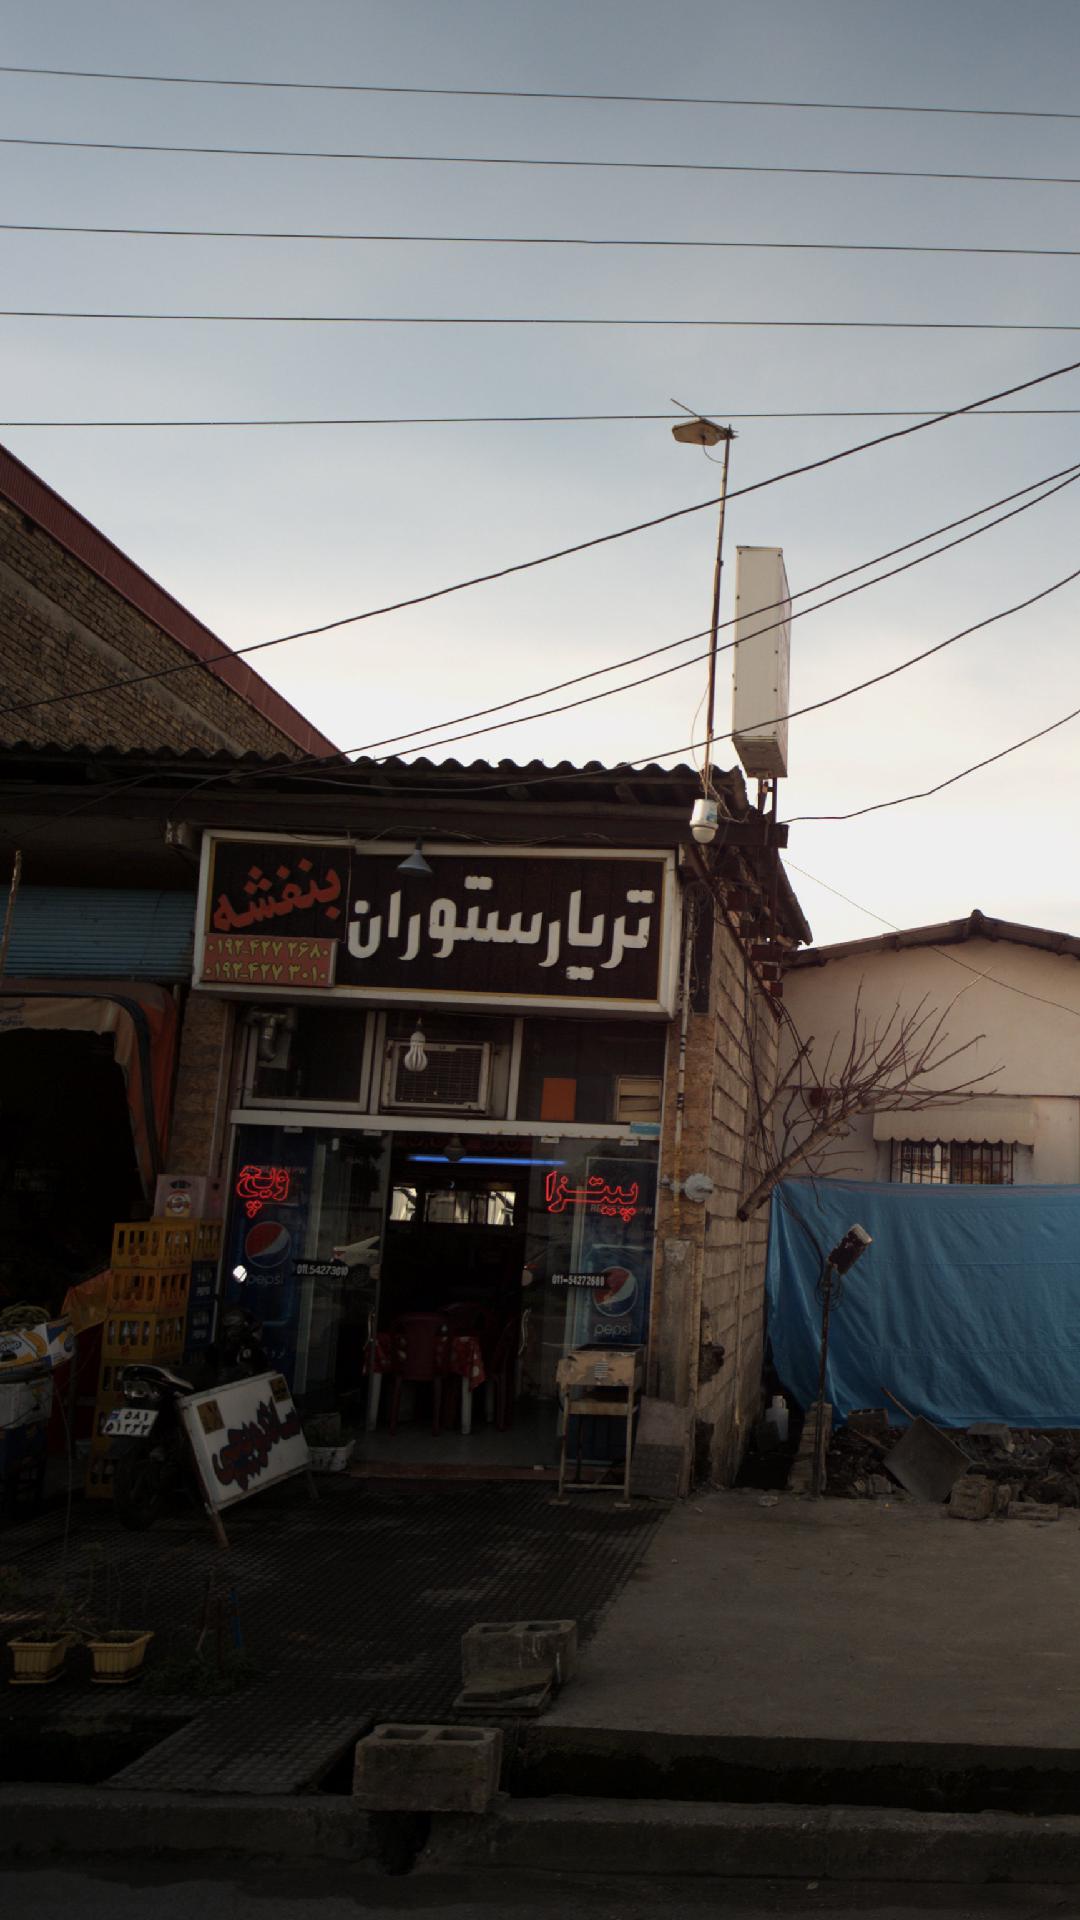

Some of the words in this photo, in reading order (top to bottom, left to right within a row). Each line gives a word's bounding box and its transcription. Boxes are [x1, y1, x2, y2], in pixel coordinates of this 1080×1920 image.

[213, 858, 341, 932] بنفشه
[347, 875, 561, 967] رستوران
[544, 1169, 640, 1223] پیتزا
[593, 1322, 632, 1338] pepsi
